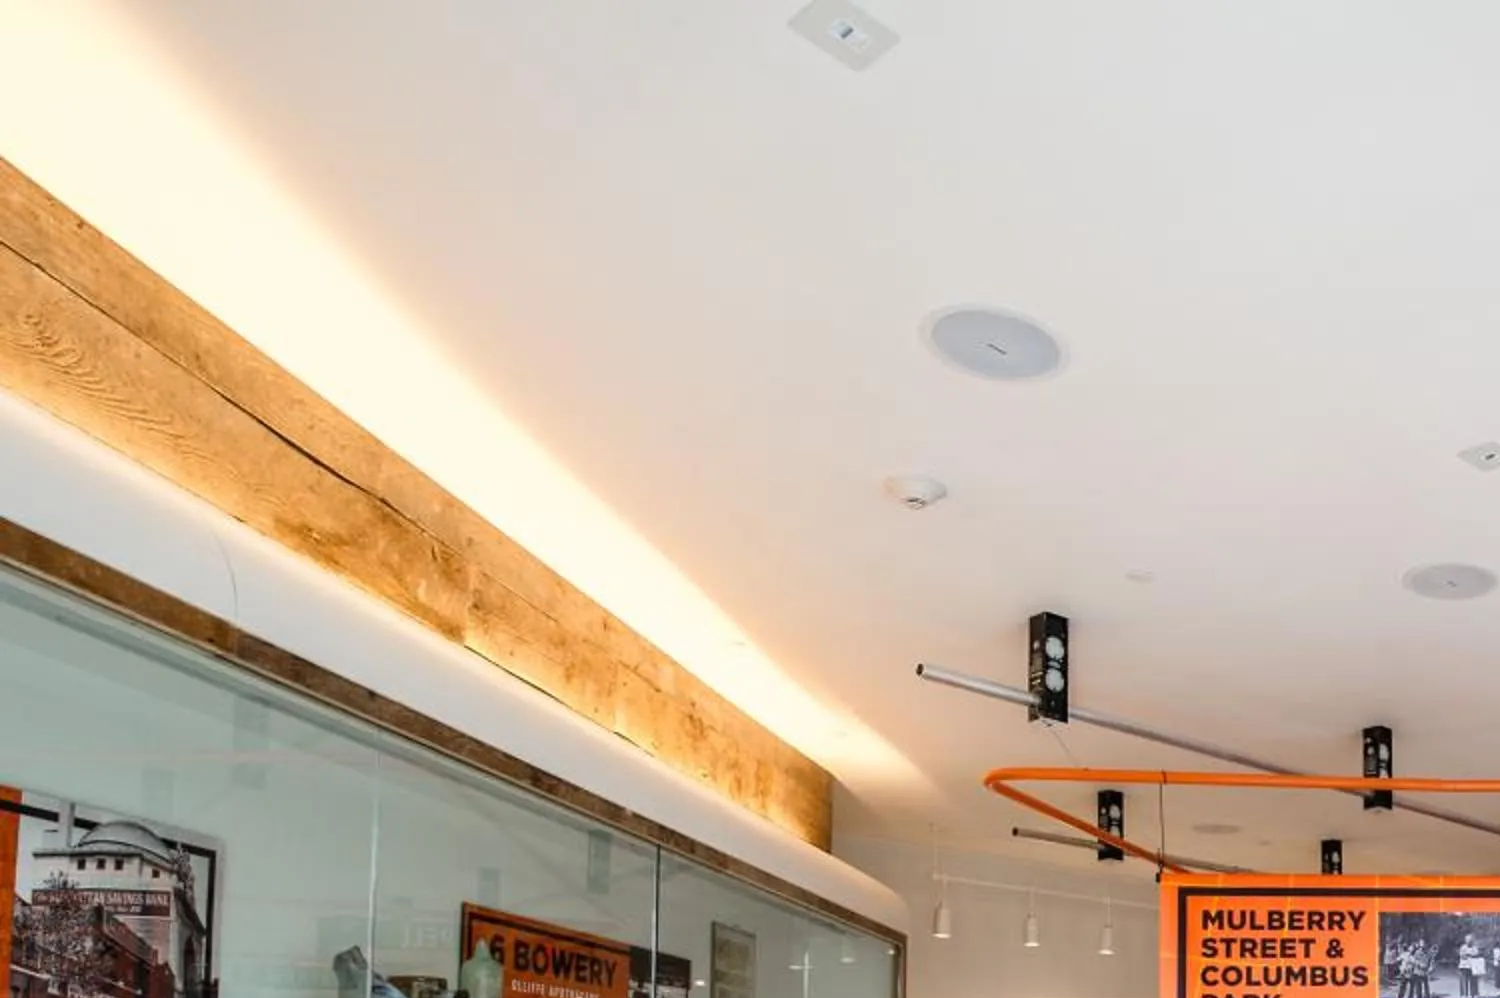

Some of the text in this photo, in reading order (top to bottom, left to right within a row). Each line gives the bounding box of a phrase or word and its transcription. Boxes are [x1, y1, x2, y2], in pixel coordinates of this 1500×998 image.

[1201, 909, 1366, 931] MULBERRY
[1201, 937, 1344, 958] STREET &
[513, 939, 618, 989] BOWERY
[1201, 966, 1369, 987] COLUMBUS
